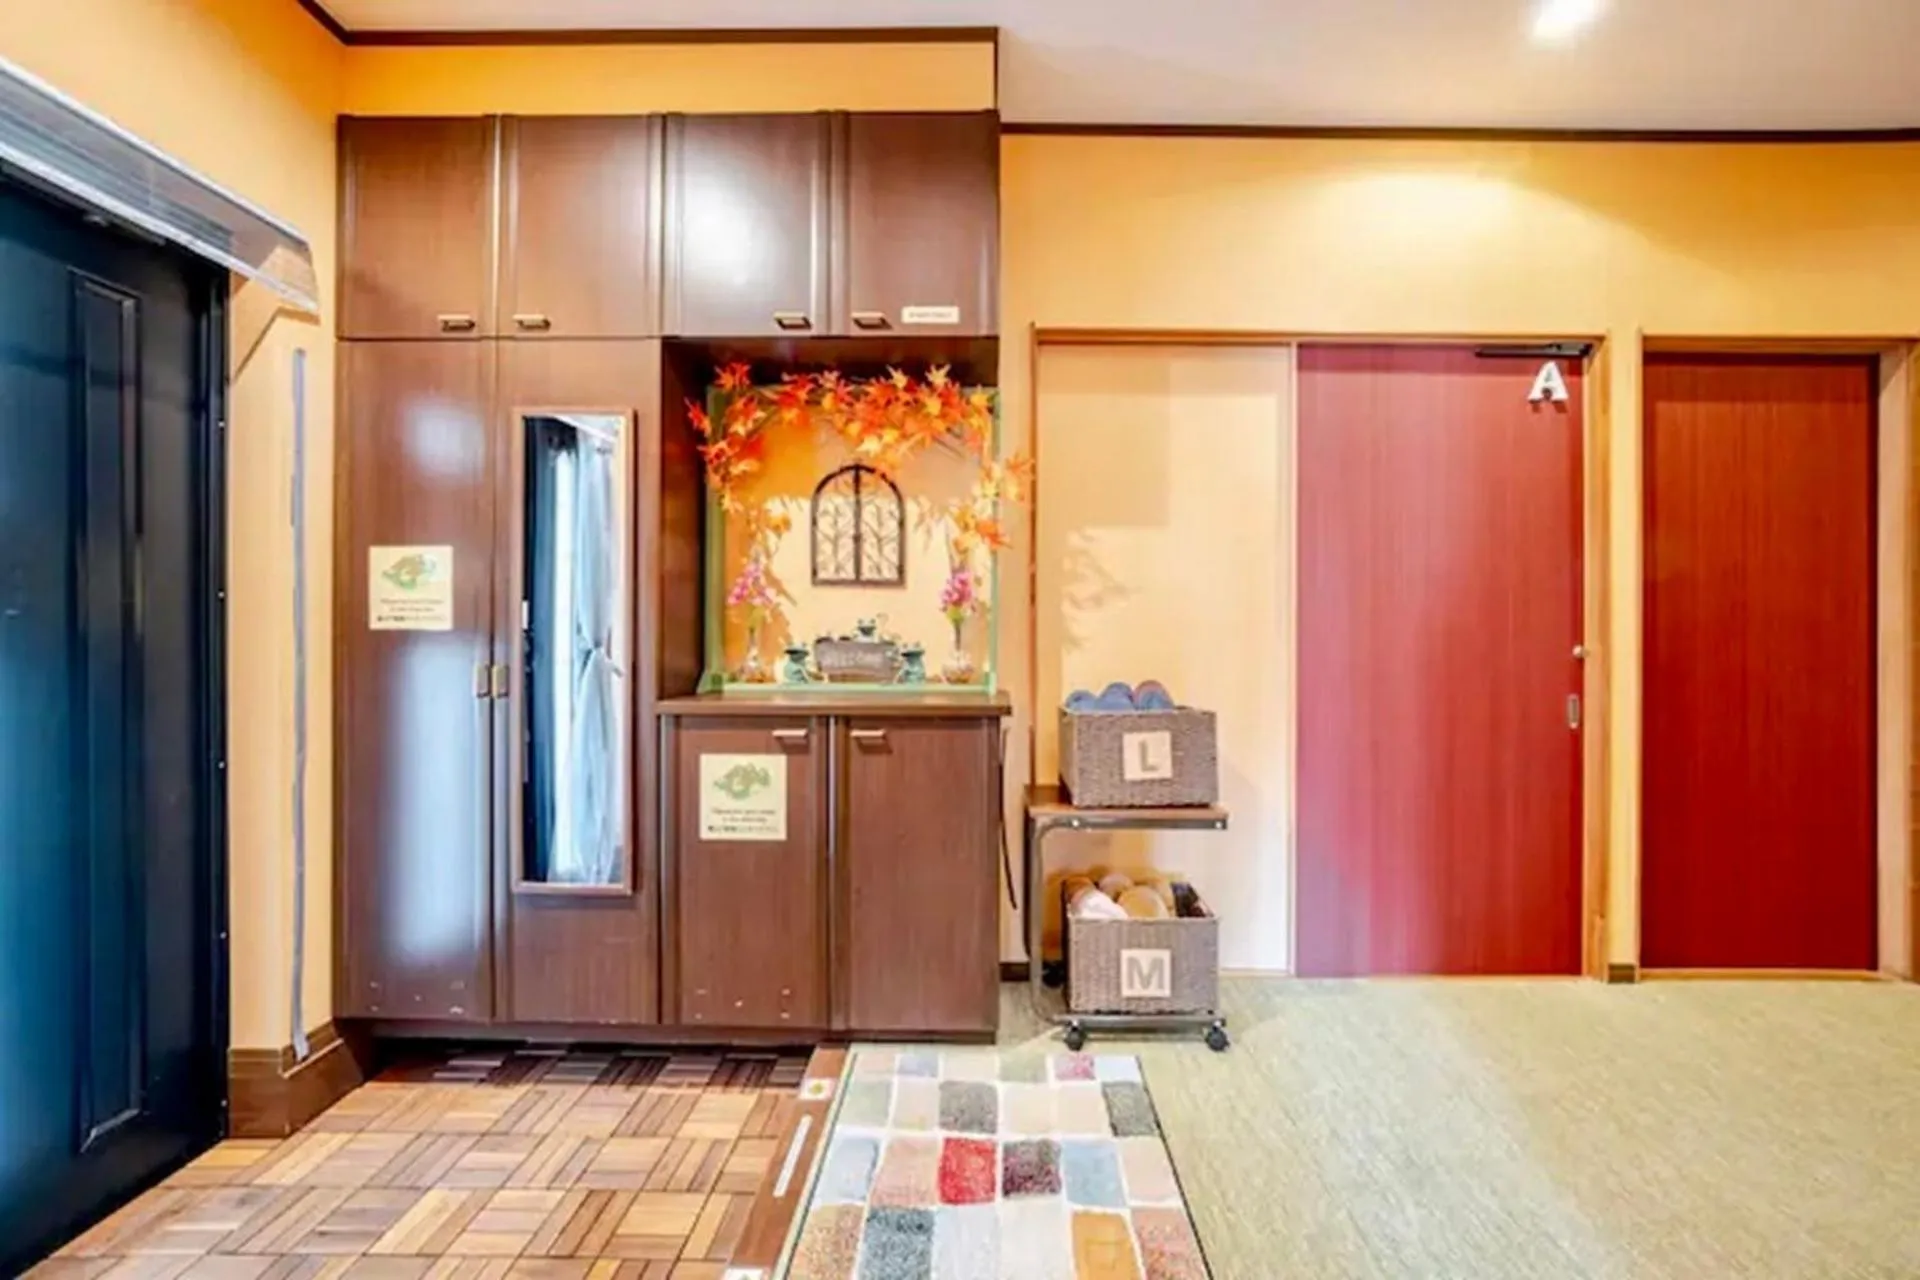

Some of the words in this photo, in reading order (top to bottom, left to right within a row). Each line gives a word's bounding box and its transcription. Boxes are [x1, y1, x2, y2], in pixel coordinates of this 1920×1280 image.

[1528, 360, 1569, 400] A
[1138, 740, 1160, 772] L
[1127, 956, 1164, 990] M
